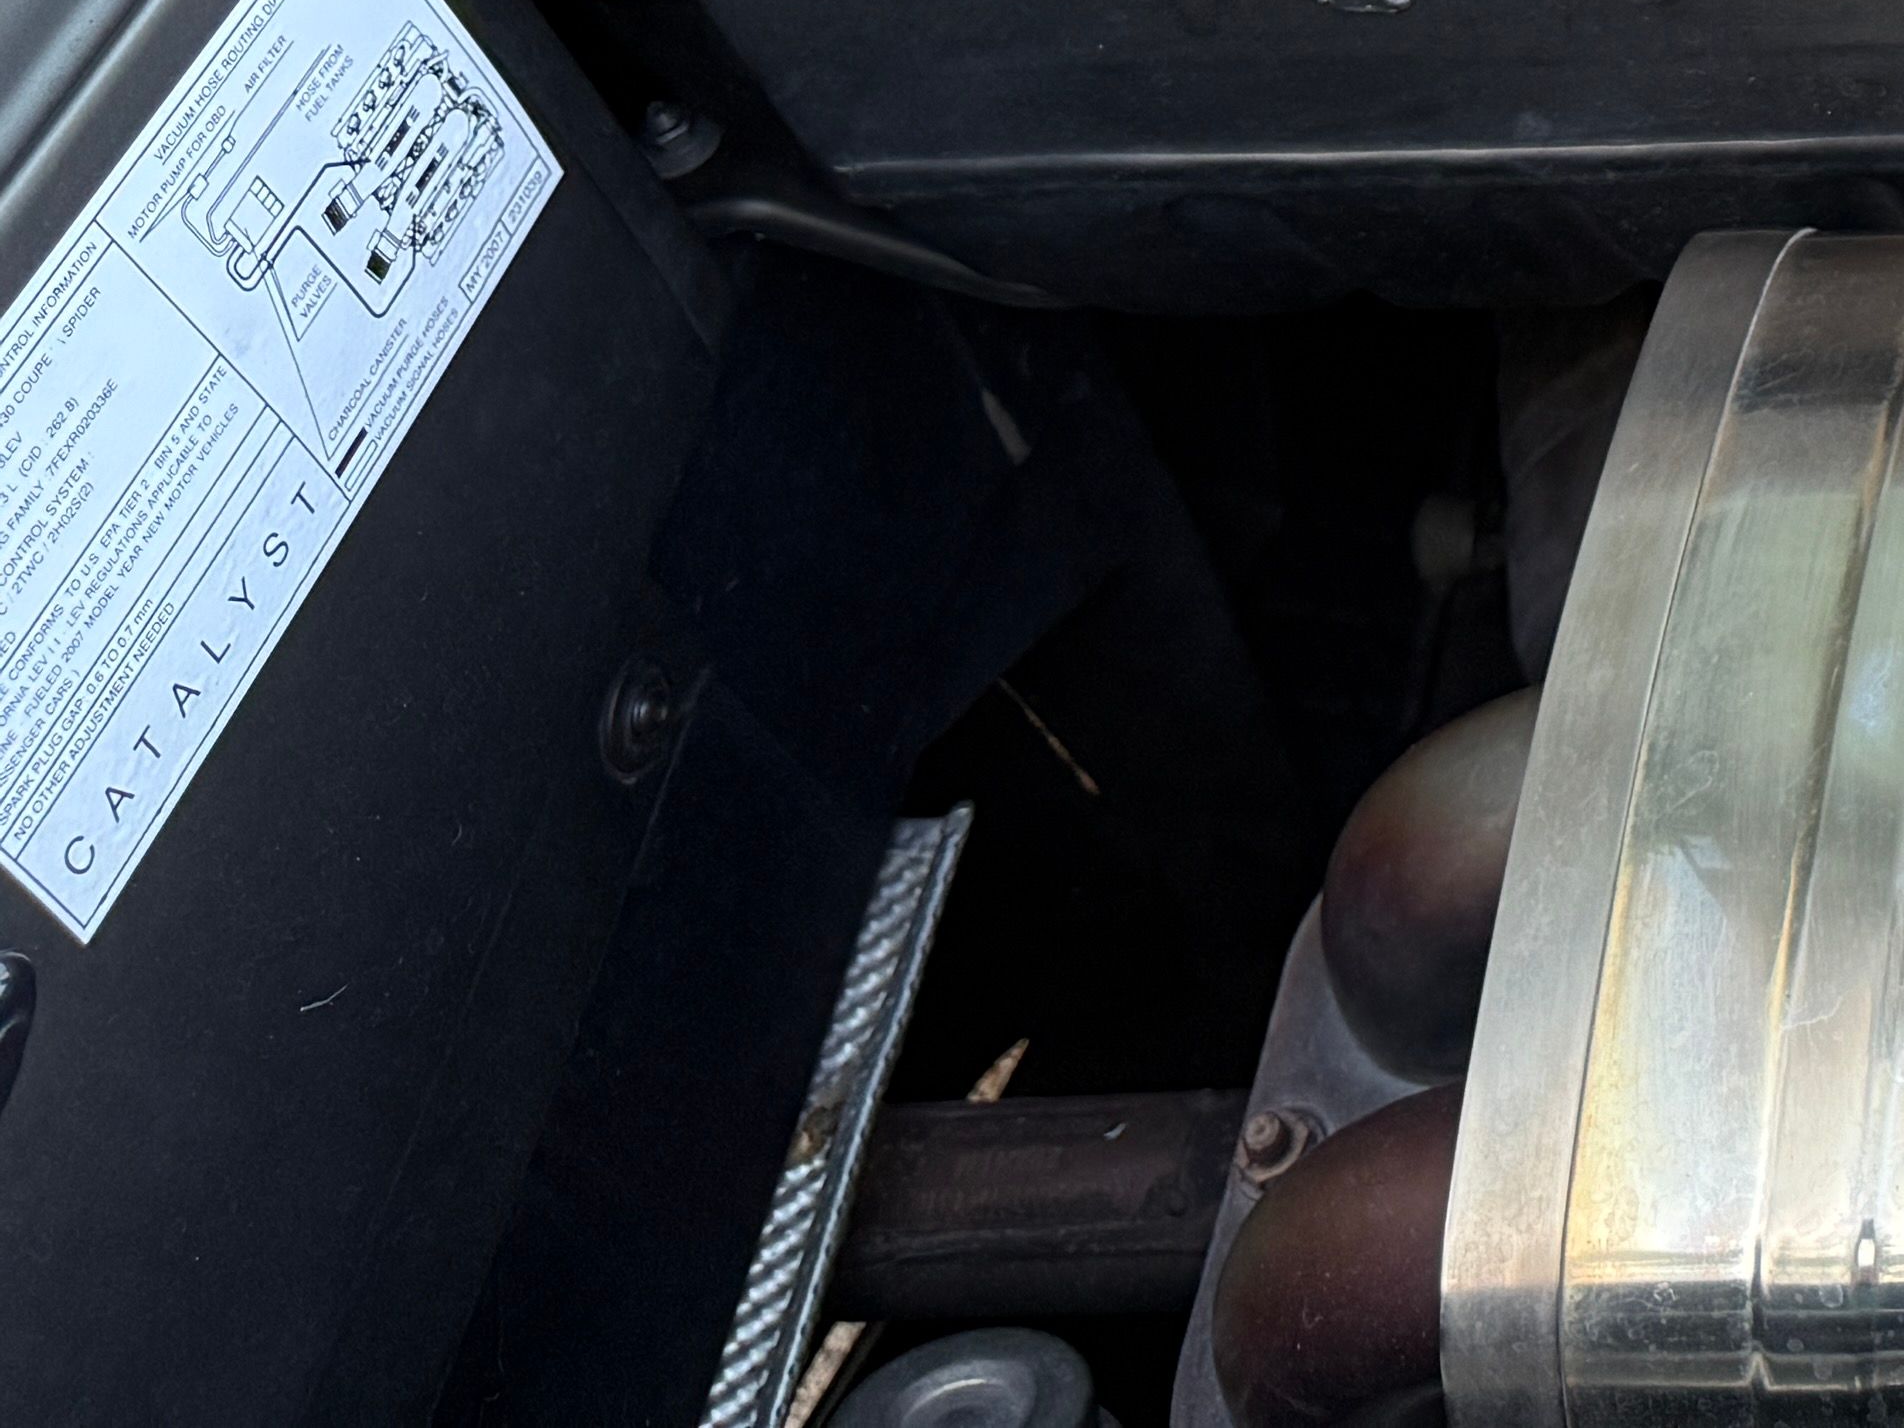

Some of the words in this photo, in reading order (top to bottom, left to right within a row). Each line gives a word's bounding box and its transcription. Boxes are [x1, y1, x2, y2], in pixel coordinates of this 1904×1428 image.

[153, 106, 196, 160] VACUUM
[194, 69, 224, 107] HOSE
[221, 14, 265, 73] ROUTING
[244, 72, 260, 94] AIR
[257, 35, 287, 74] FILTER
[295, 77, 322, 112] HOSE
[318, 44, 344, 79] FROM
[304, 94, 329, 122] FUEL
[325, 55, 354, 92] TANKS
[127, 192, 163, 239] MOTOR
[160, 157, 186, 194] PUMP
[185, 131, 207, 159] FOR
[205, 104, 226, 133] OBD
[32, 242, 97, 327] INFORMATION
[290, 264, 322, 308] PURGE
[480, 230, 511, 269] 2007
[299, 274, 332, 318] VALVES
[12, 353, 53, 404] COUPE
[62, 286, 101, 338] SPIDER
[328, 378, 372, 442] CHARCOAL
[369, 318, 408, 376] CANISTER
[365, 377, 399, 428] VACUUM
[396, 336, 424, 379] PURGE
[374, 390, 408, 441] VACUUM
[405, 350, 435, 392] SIGNAL
[6, 480, 44, 531] FAMILY
[8, 603, 64, 681] CONFORMS
[64, 578, 82, 597] TO
[99, 523, 121, 549] EPA
[118, 490, 142, 519] TIER
[153, 445, 173, 470] BIN
[179, 405, 200, 435] AND
[198, 365, 227, 404] STATE
[45, 458, 89, 517] SYSTEM
[11, 550, 44, 595] 2TWC
[23, 664, 63, 718] FUELED
[60, 630, 84, 664] 2007
[83, 585, 119, 629] MODEL
[116, 545, 144, 578] YEAR
[141, 510, 165, 544] NEW
[164, 463, 198, 511] MOTOR
[196, 403, 239, 462] VEHICLES
[27, 654, 48, 683] LEV
[65, 599, 86, 628] LEV
[84, 510, 148, 599] REGULATIONS
[147, 434, 199, 510] APPLICABLE
[196, 414, 213, 432] TO
[0, 774, 35, 826] SPARK
[31, 732, 63, 775] PLUG
[100, 648, 119, 669] TO
[133, 598, 154, 625] mm
[13, 815, 34, 841] NO
[31, 760, 71, 814] OTHER
[69, 662, 134, 761] ADJUSTMENT
[132, 602, 175, 663] NEEDED
[44, 677, 73, 716] CARS
[64, 482, 315, 875] CATALYST
